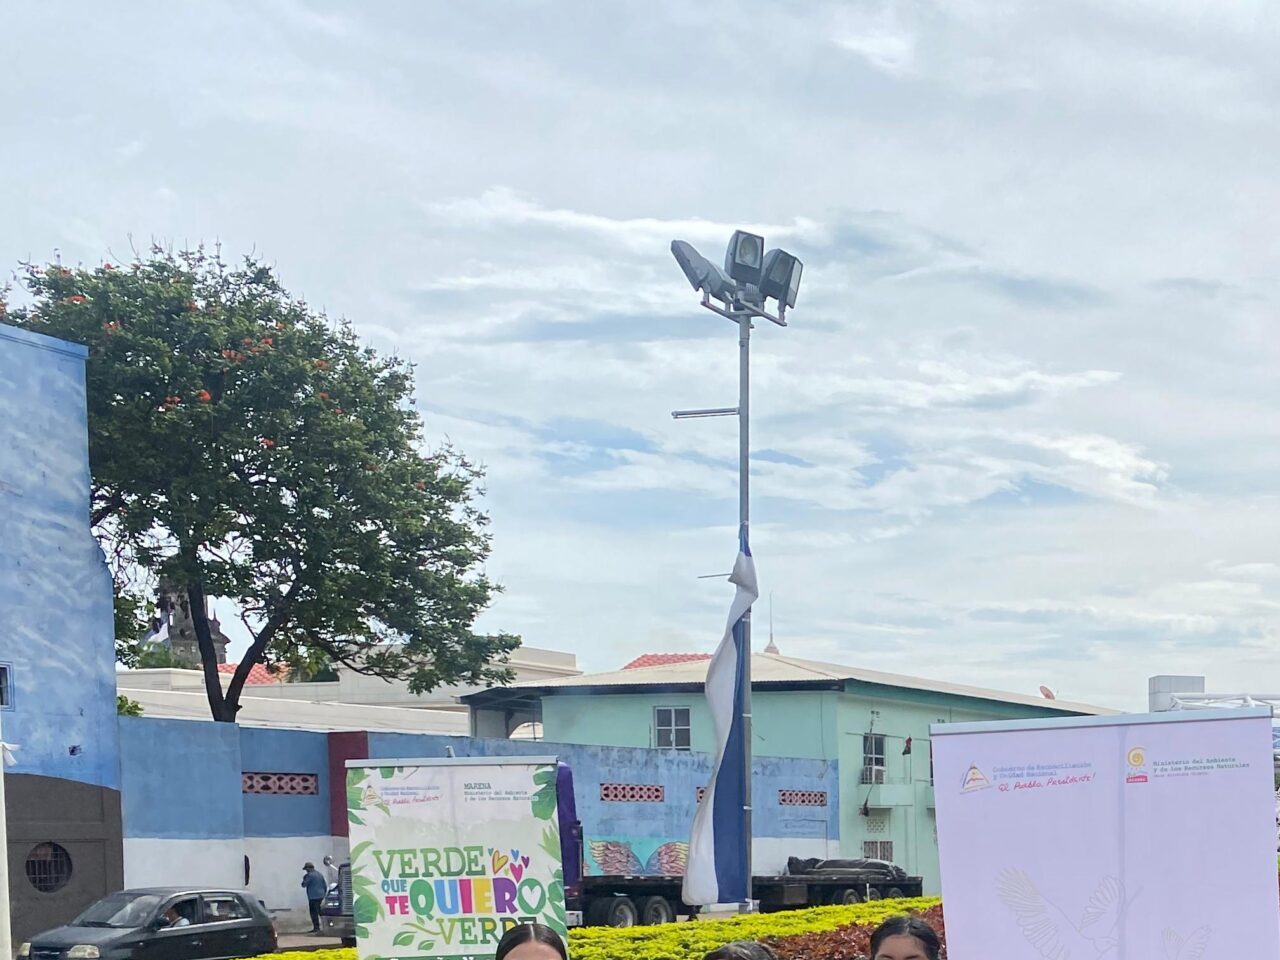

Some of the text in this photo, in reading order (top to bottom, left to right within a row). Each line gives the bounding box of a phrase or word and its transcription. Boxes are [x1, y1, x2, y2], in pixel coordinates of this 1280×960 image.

[1153, 759, 1190, 767] Ministerio
[1216, 762, 1250, 770] Naturales
[372, 846, 486, 879] VERDE
[381, 879, 408, 894] QUE
[385, 895, 409, 915] TE
[409, 877, 546, 921] QUIERO
